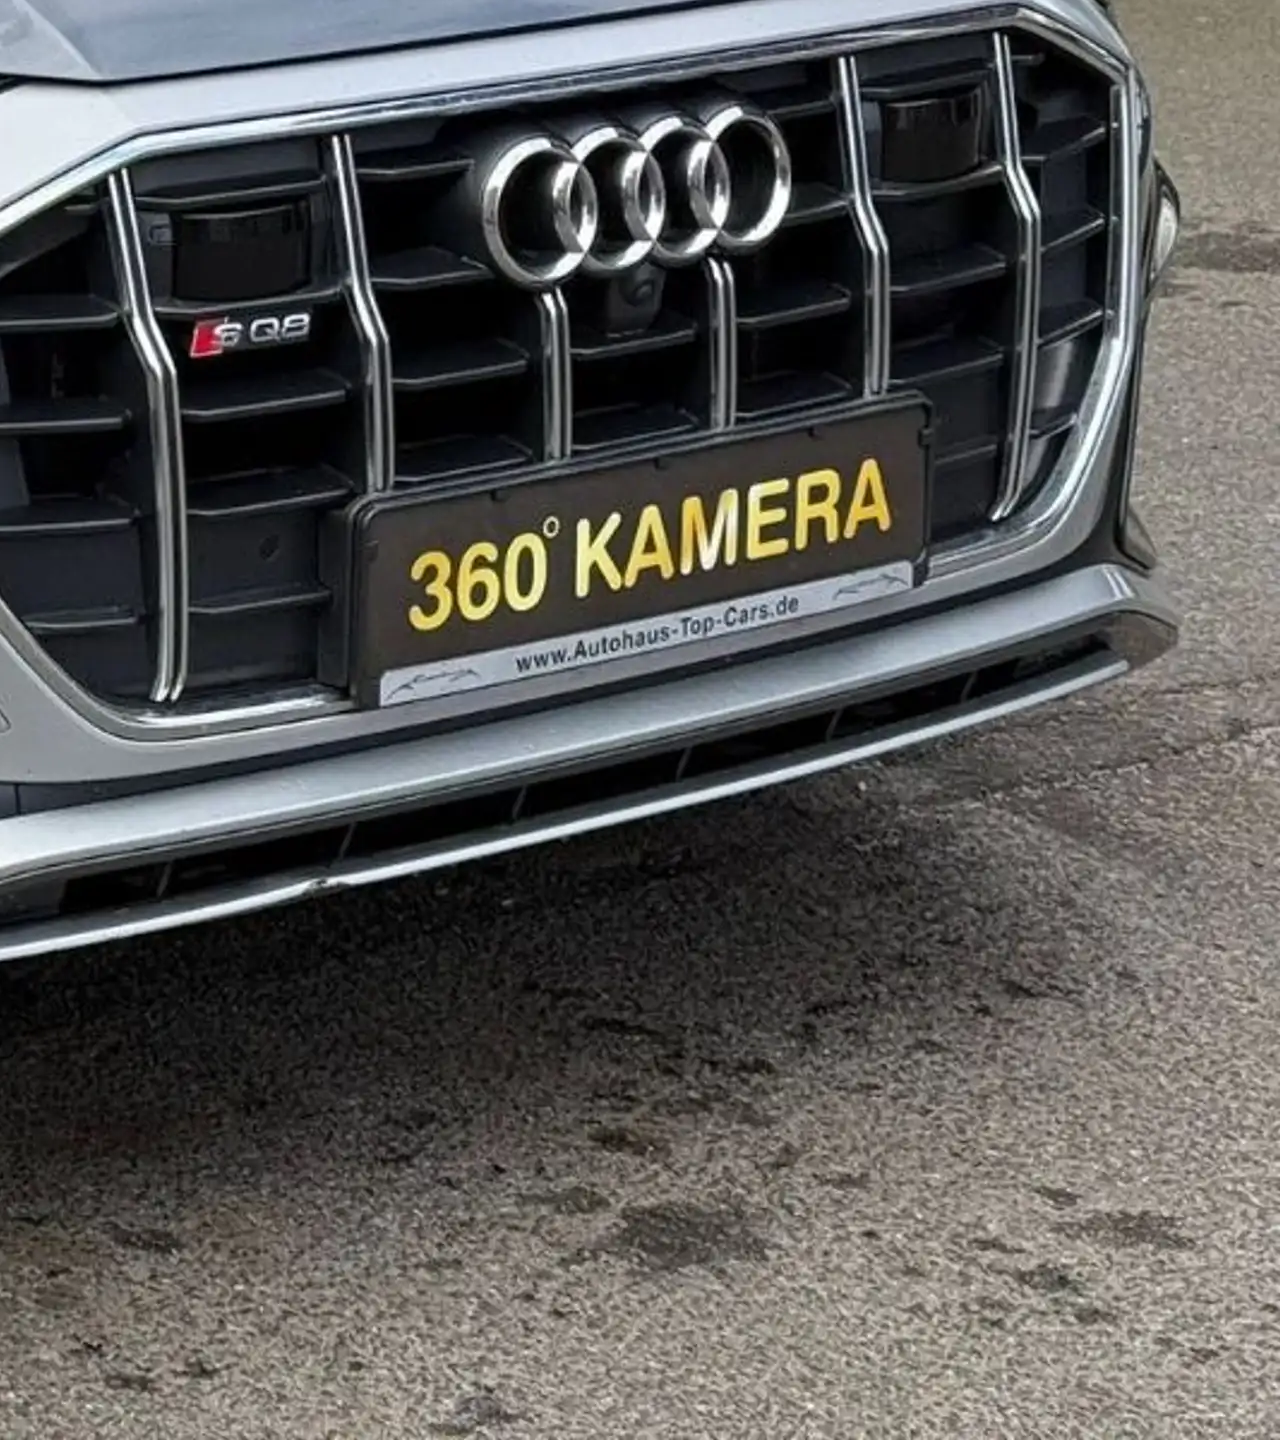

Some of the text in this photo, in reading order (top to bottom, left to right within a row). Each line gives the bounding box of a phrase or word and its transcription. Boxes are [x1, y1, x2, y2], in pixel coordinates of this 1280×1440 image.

[407, 456, 892, 632] 360° KAMERA
[515, 592, 801, 674] www.Autohaus-Top-Cars.de
